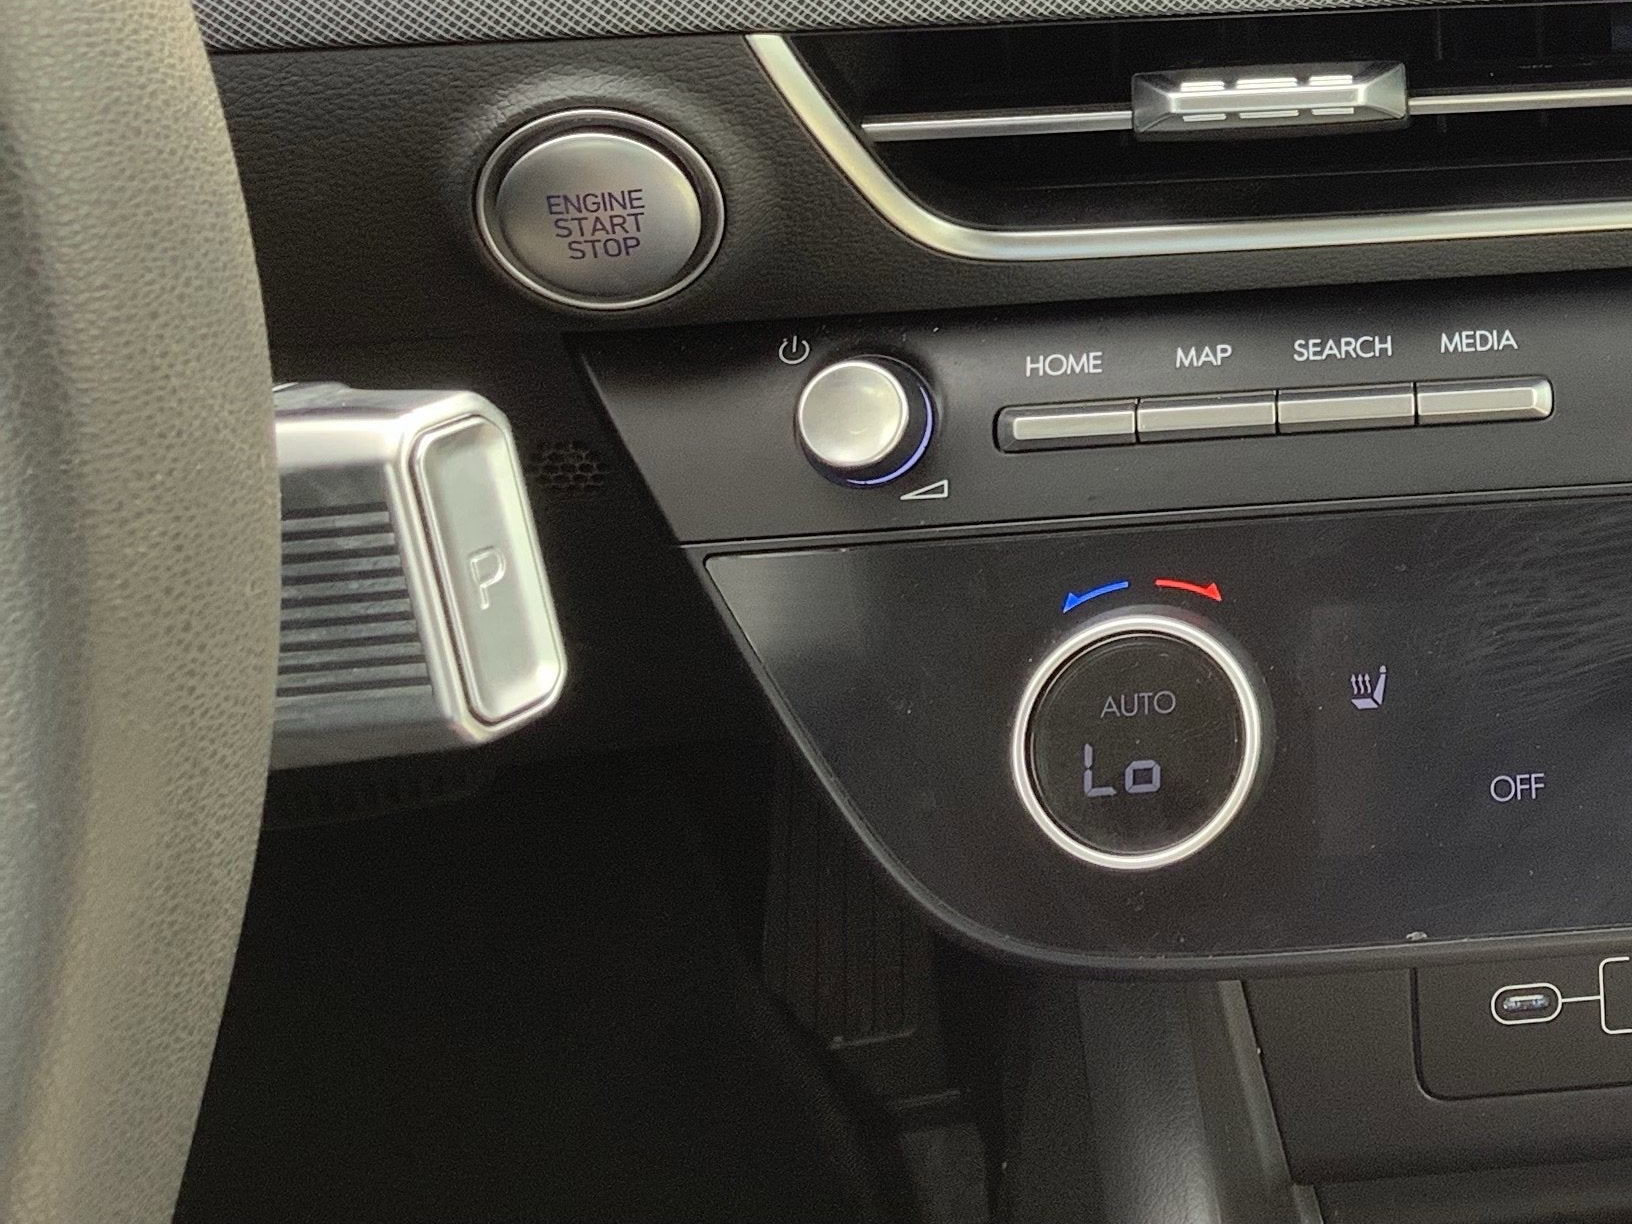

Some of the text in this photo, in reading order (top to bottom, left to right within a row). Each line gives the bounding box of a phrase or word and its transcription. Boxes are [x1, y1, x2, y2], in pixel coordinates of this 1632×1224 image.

[546, 188, 646, 216] ENGINE
[553, 212, 645, 239] START
[567, 236, 641, 260] STOP
[1293, 335, 1393, 362] SEARCH
[1439, 329, 1519, 354] MEDIA
[1025, 351, 1103, 377] HOME
[1175, 344, 1233, 368] MAP
[468, 545, 507, 611] P
[1100, 690, 1177, 718] AUTO
[1490, 772, 1545, 803] OFF
